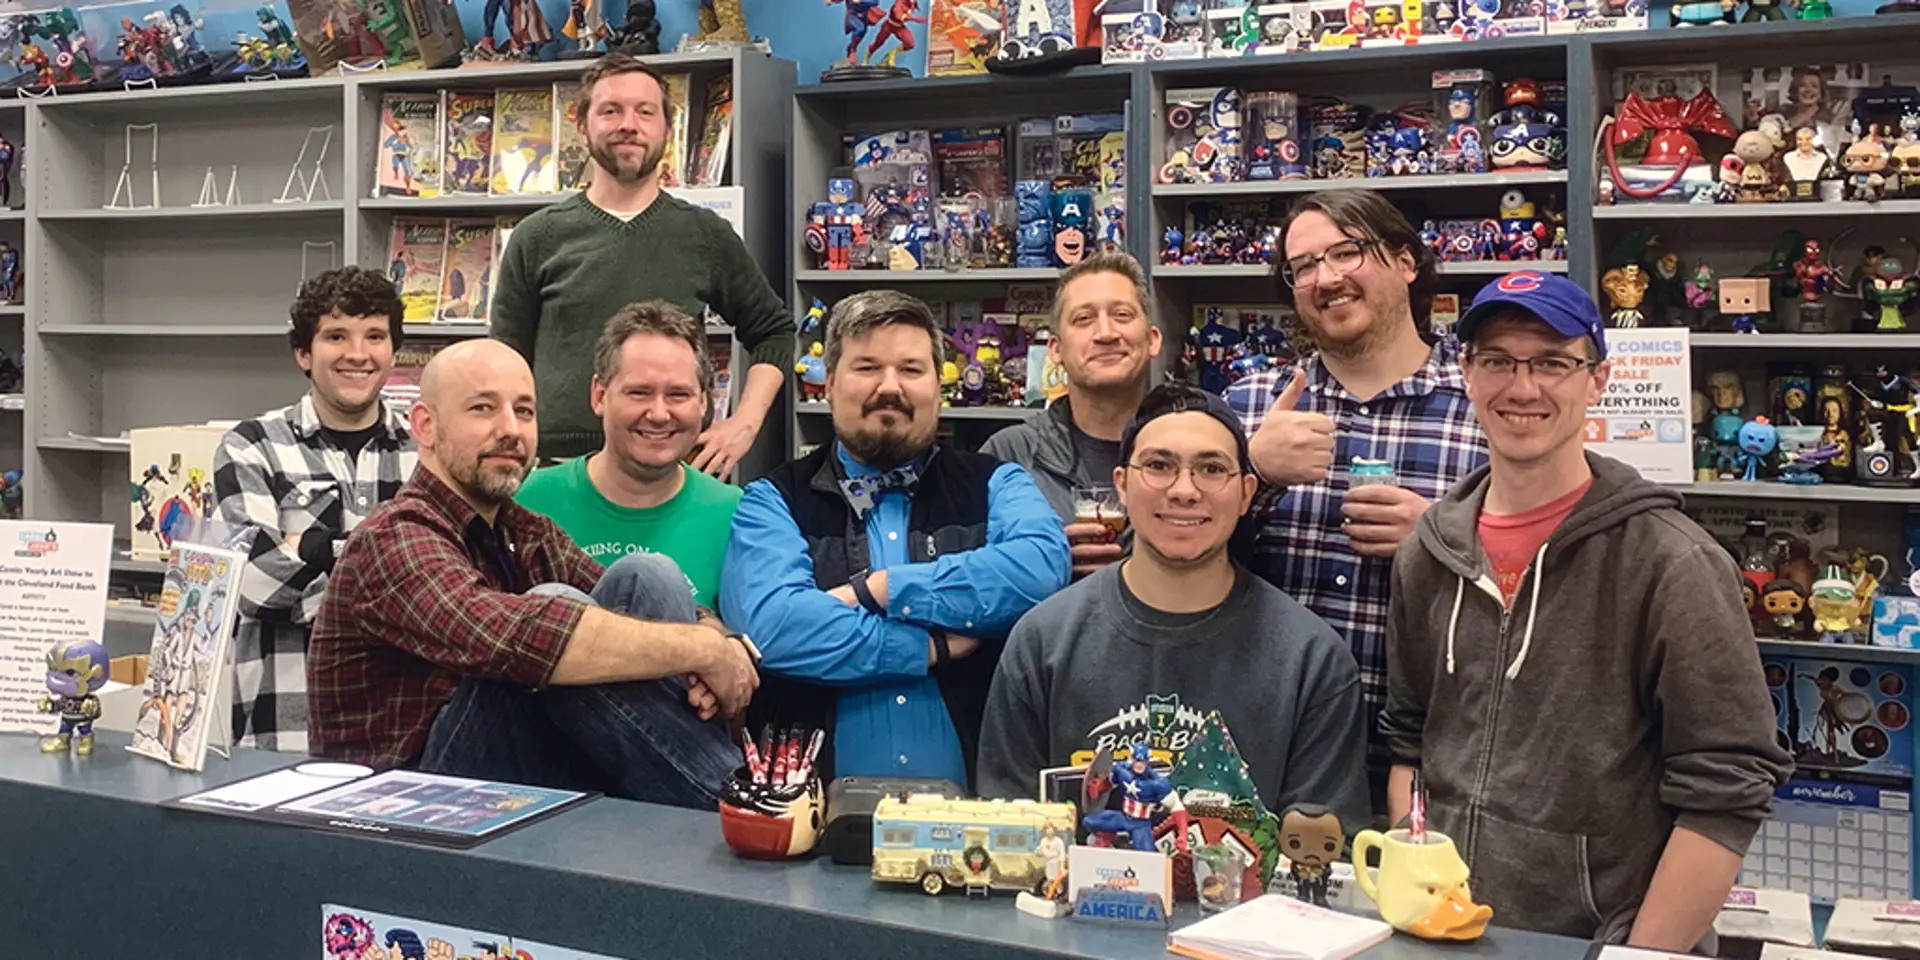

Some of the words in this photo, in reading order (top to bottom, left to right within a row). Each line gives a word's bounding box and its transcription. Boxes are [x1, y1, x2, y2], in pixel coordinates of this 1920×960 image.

[1062, 203, 1082, 217] A
[1498, 270, 1544, 291] C
[1617, 341, 1683, 353] COMICS
[1631, 356, 1683, 366] FRIDAY
[1613, 369, 1649, 380] SALE
[1605, 383, 1630, 393] 0%
[1635, 382, 1664, 393] OFF
[1596, 396, 1681, 408] VERYTHING
[50, 568, 62, 577] Art
[64, 569, 83, 578] Show
[18, 578, 54, 588] Cleveland
[56, 581, 74, 590] Food
[76, 583, 97, 591] Bank
[1792, 785, 1855, 802] november
[1079, 901, 1158, 921] AMERICA
